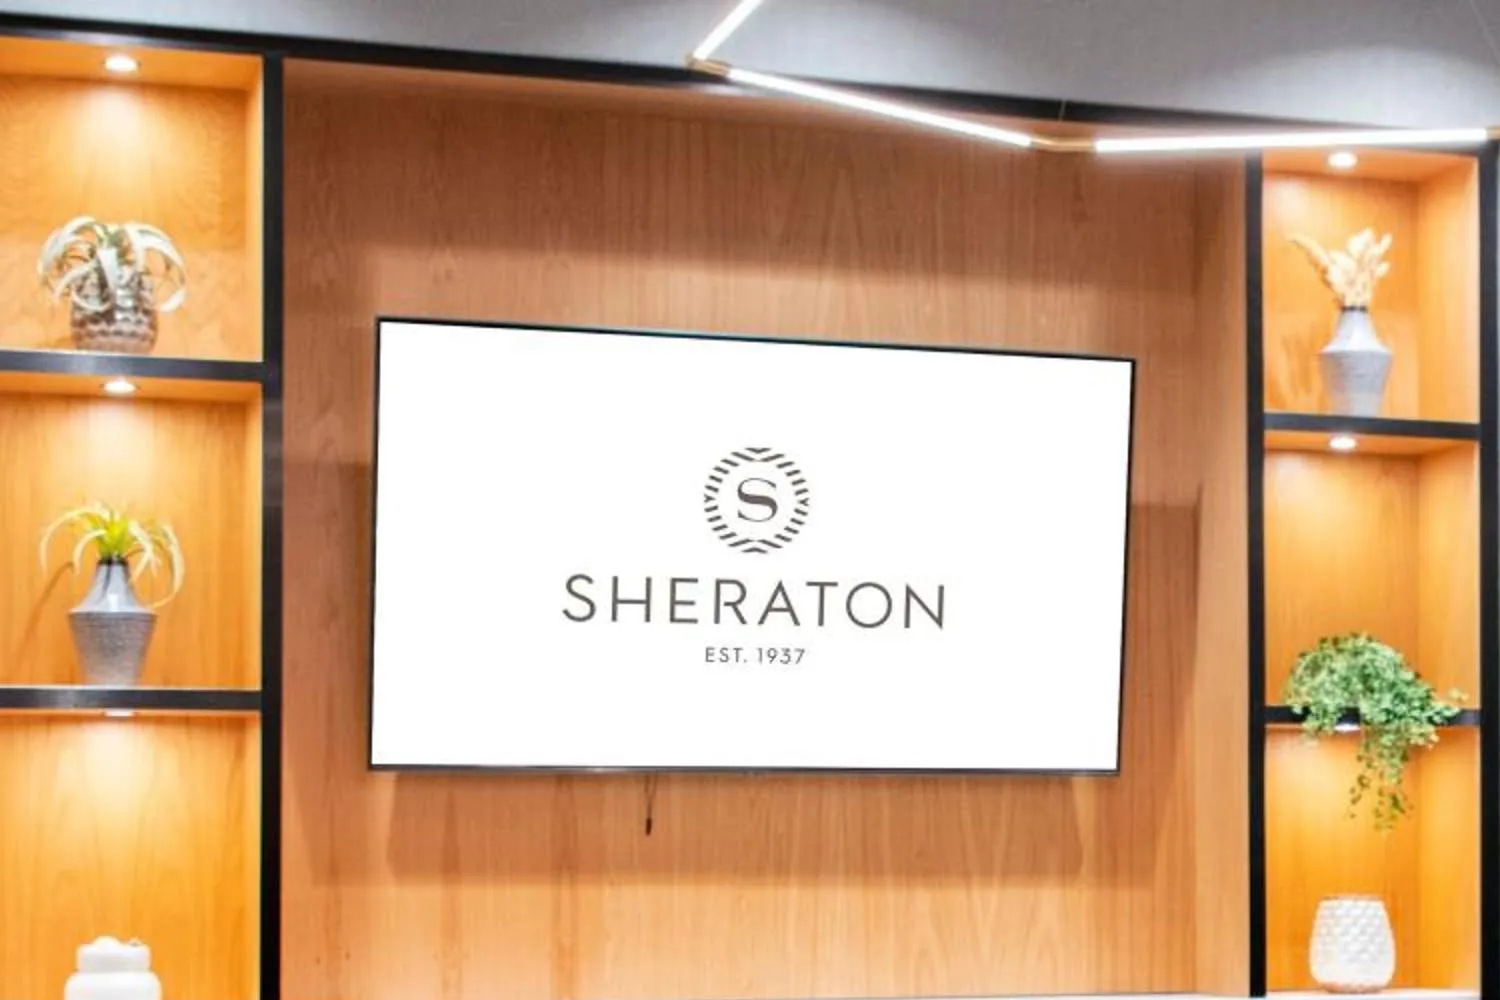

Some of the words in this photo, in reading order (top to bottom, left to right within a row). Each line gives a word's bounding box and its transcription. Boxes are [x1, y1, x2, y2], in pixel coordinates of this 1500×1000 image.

[736, 477, 778, 522] S
[562, 573, 945, 630] SHERATON
[704, 646, 748, 664] EST.
[757, 647, 806, 666] 1937
